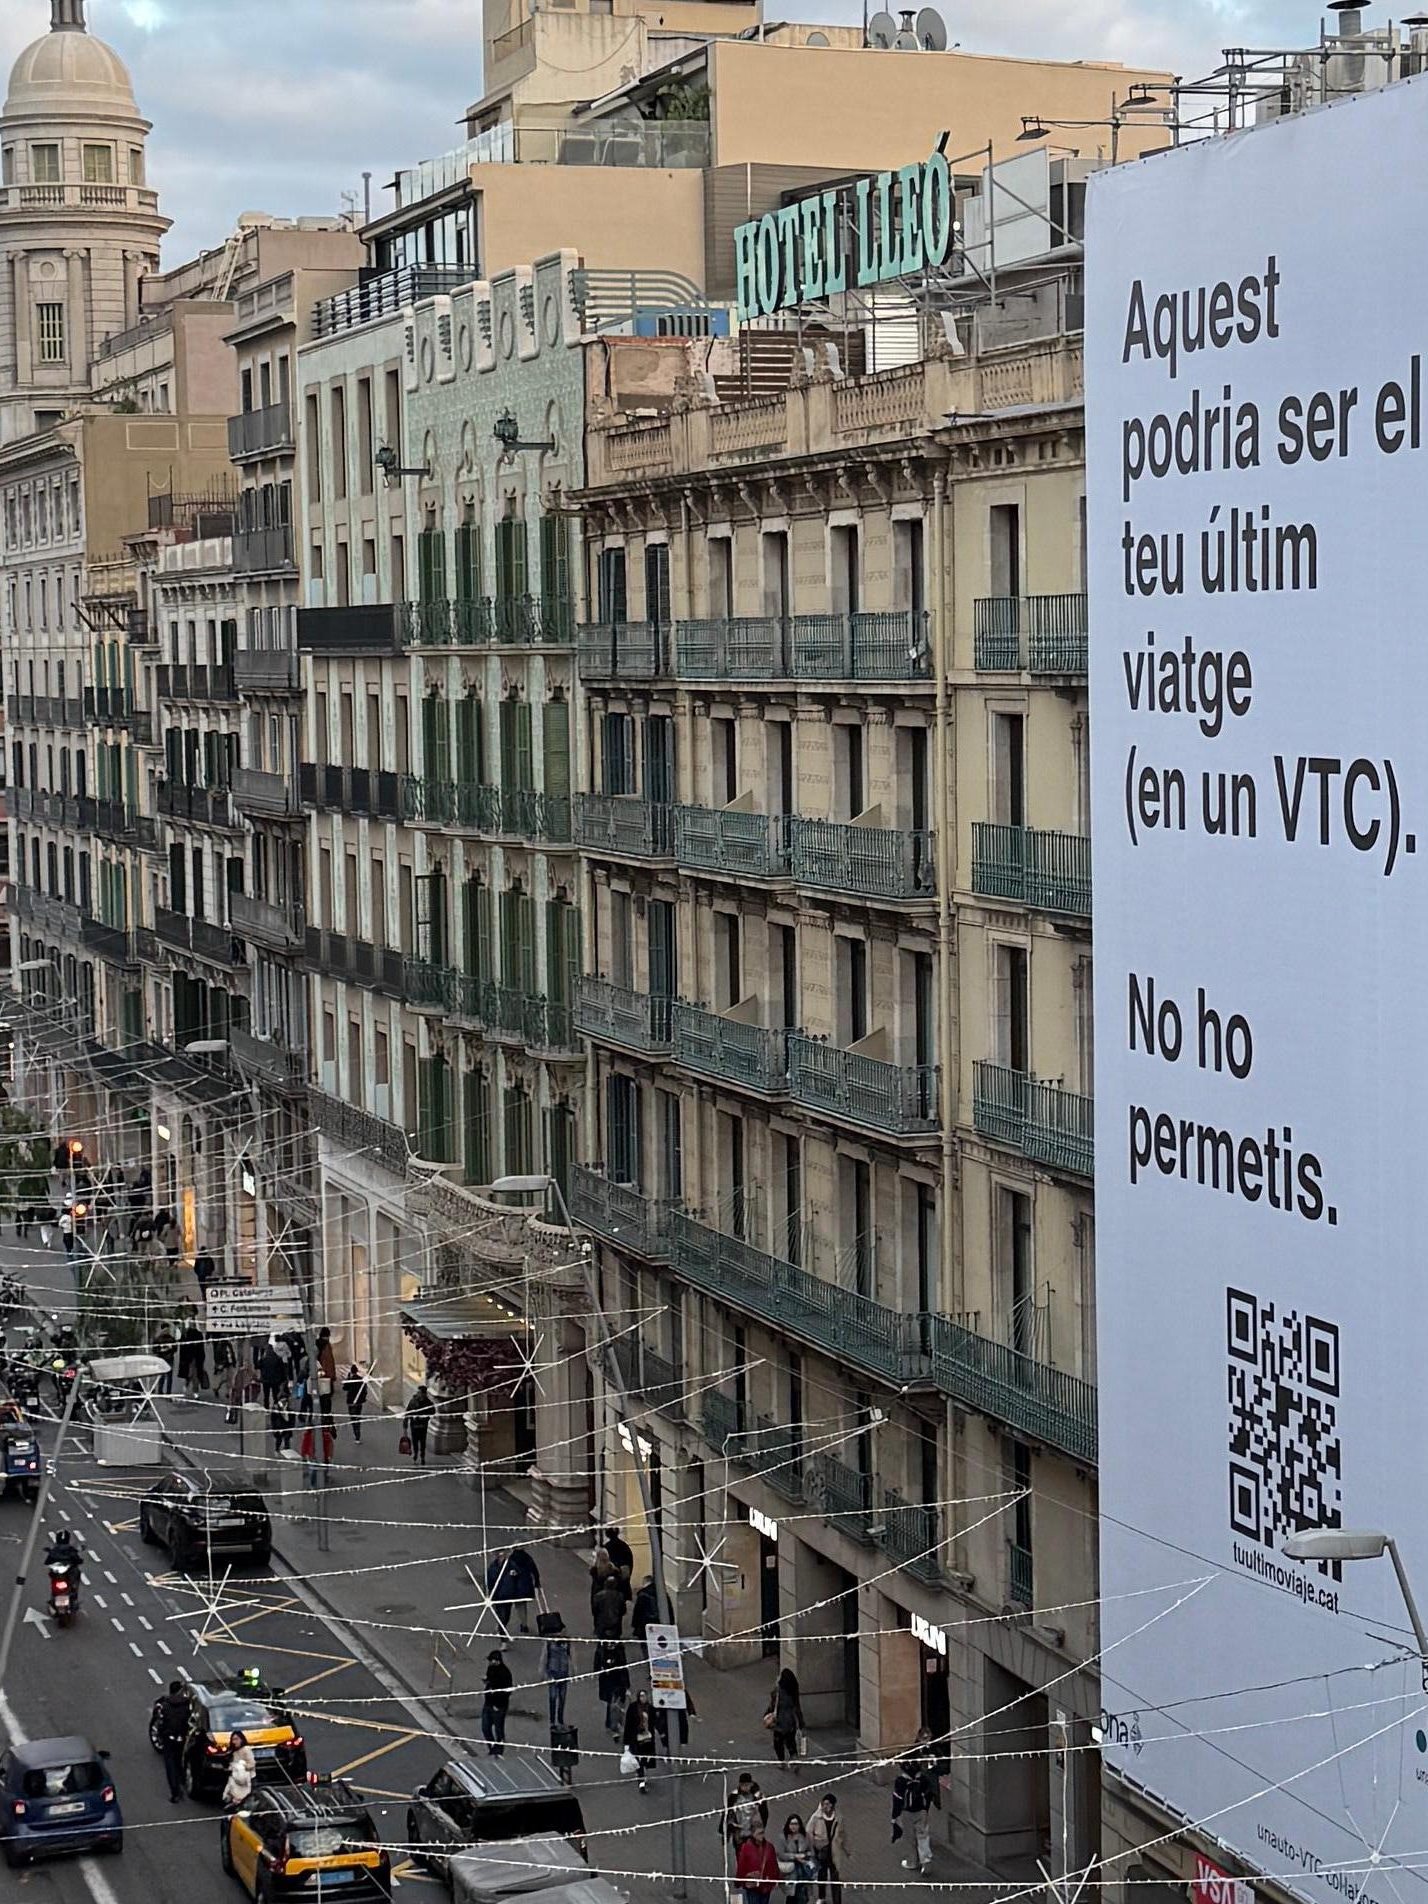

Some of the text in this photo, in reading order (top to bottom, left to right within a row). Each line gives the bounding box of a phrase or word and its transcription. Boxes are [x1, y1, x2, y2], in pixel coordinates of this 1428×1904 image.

[734, 130, 952, 322] HOTEL LLEÓ
[1123, 256, 1280, 378] Aquest
[1123, 355, 1422, 501] podria ser el
[1123, 505, 1318, 596] teu últim
[1123, 631, 1253, 737] viatge
[1126, 745, 1416, 876] (en un VTC).
[1129, 973, 1254, 1079] No ho
[1129, 1105, 1338, 1225] permetis.
[1233, 1541, 1339, 1614] tuultimoviaje.cat
